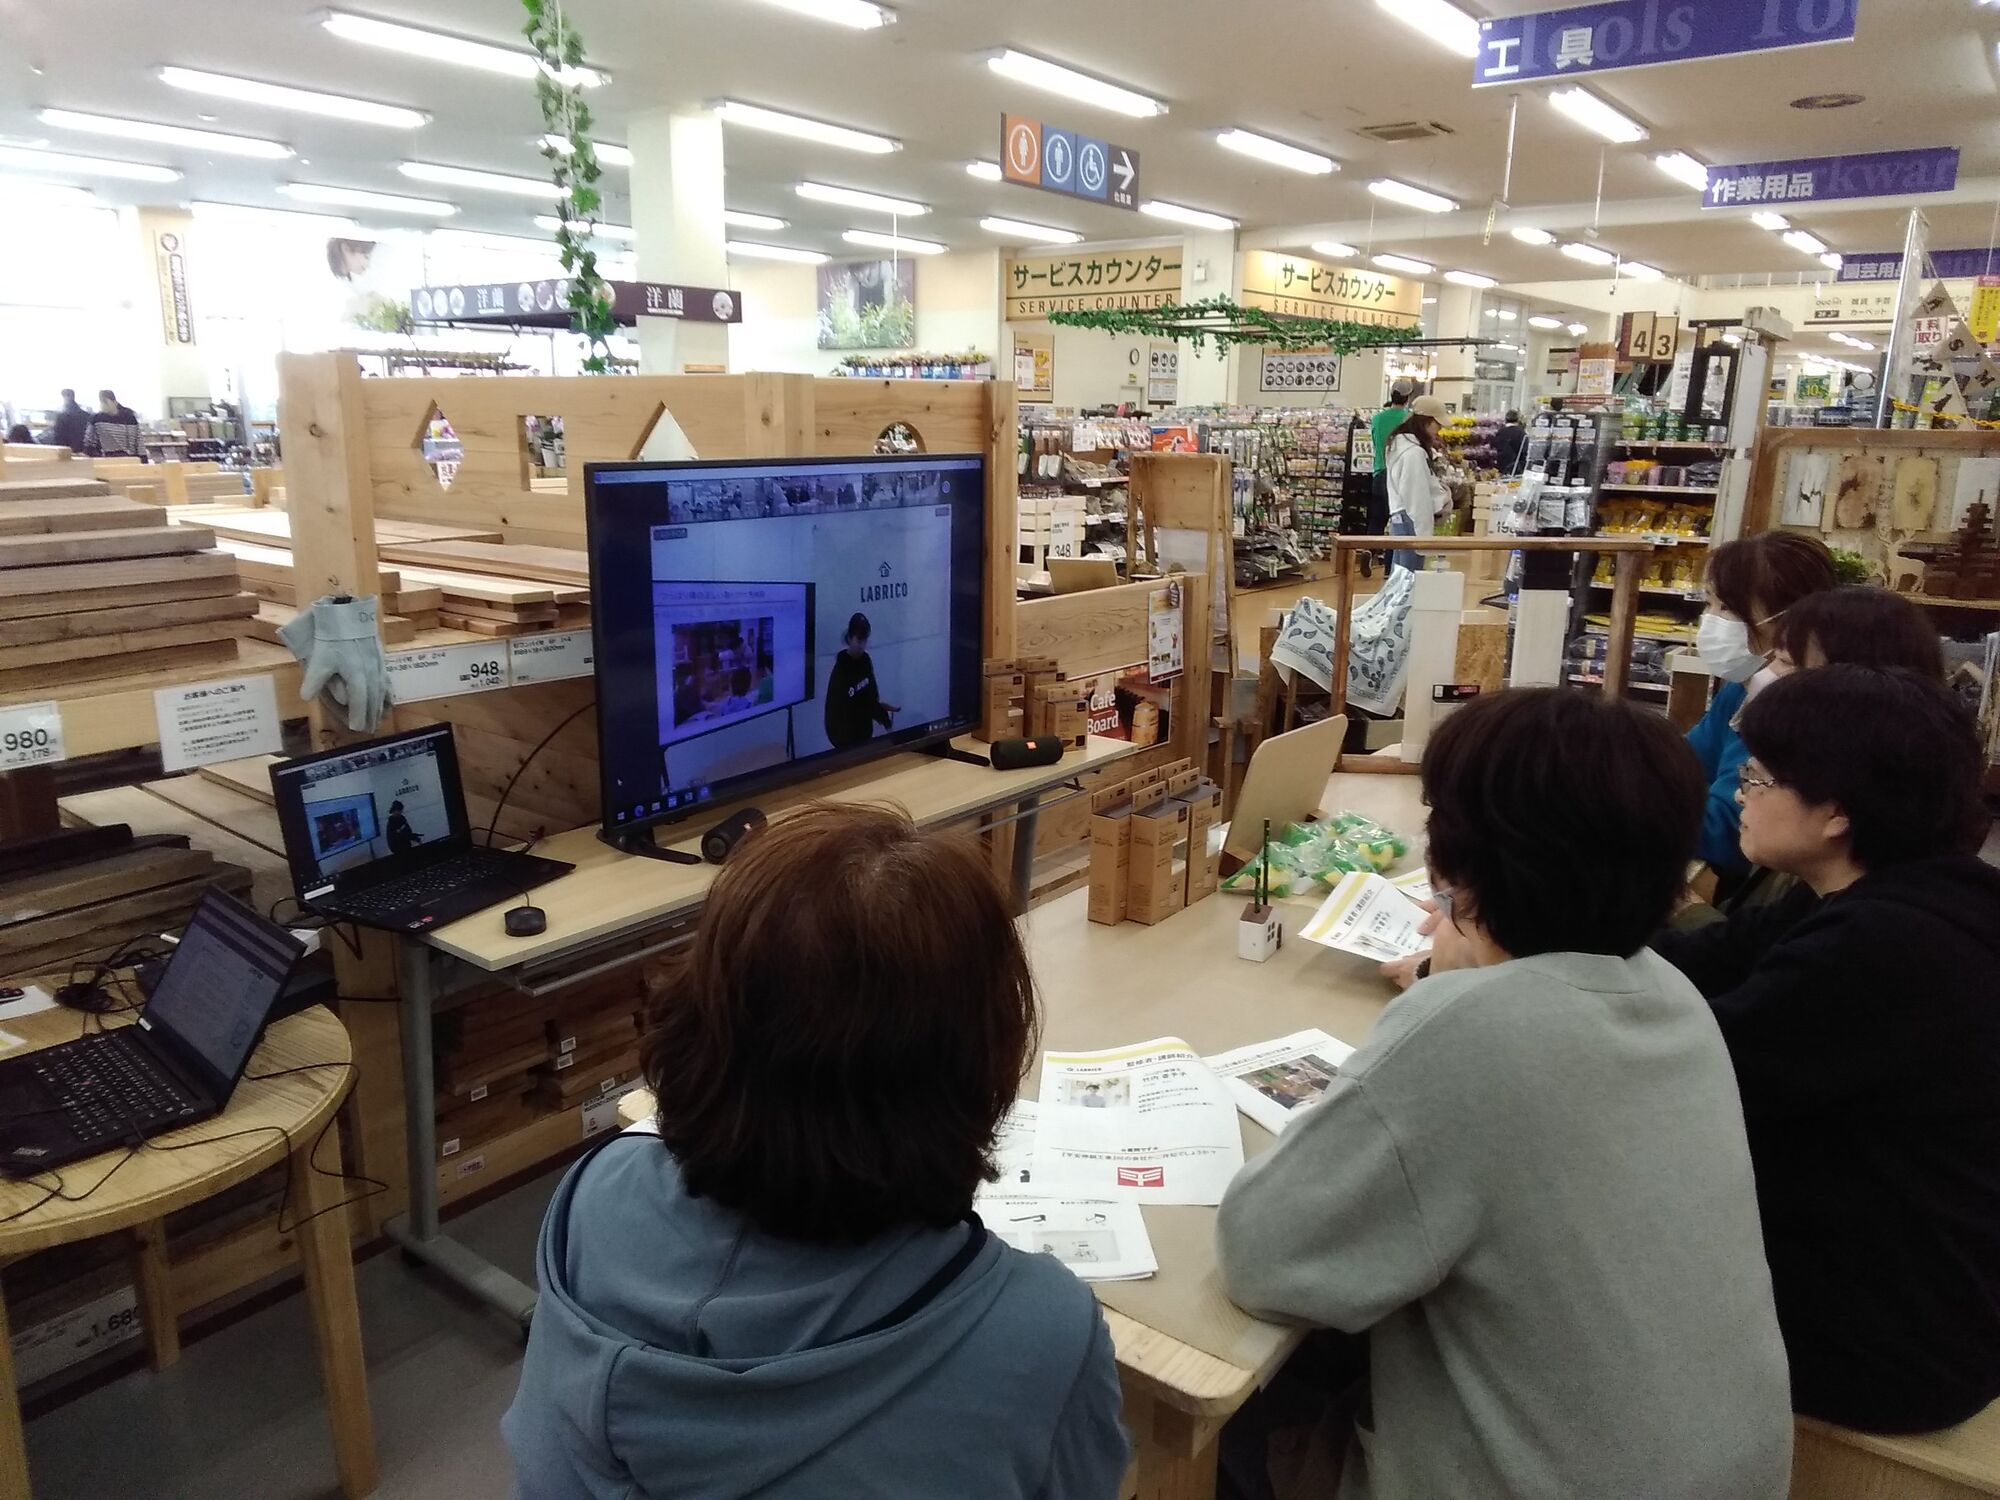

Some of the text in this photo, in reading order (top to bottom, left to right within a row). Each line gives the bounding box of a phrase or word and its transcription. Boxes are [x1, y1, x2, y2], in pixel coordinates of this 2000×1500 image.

[1484, 27, 1594, 77] 工具
[1712, 172, 1814, 203] 作業用品
[1014, 255, 1182, 290] サービスカウンター
[1282, 262, 1396, 303] サービスカウンター
[1019, 293, 1174, 314] SERVICE COUNTER
[1273, 299, 1401, 328] SERVICE COUNTER
[1634, 331, 1647, 353] 4
[1657, 335, 1671, 356] 3
[861, 582, 908, 603] LABRICO
[470, 660, 499, 678] 948
[1088, 710, 1119, 734] Board
